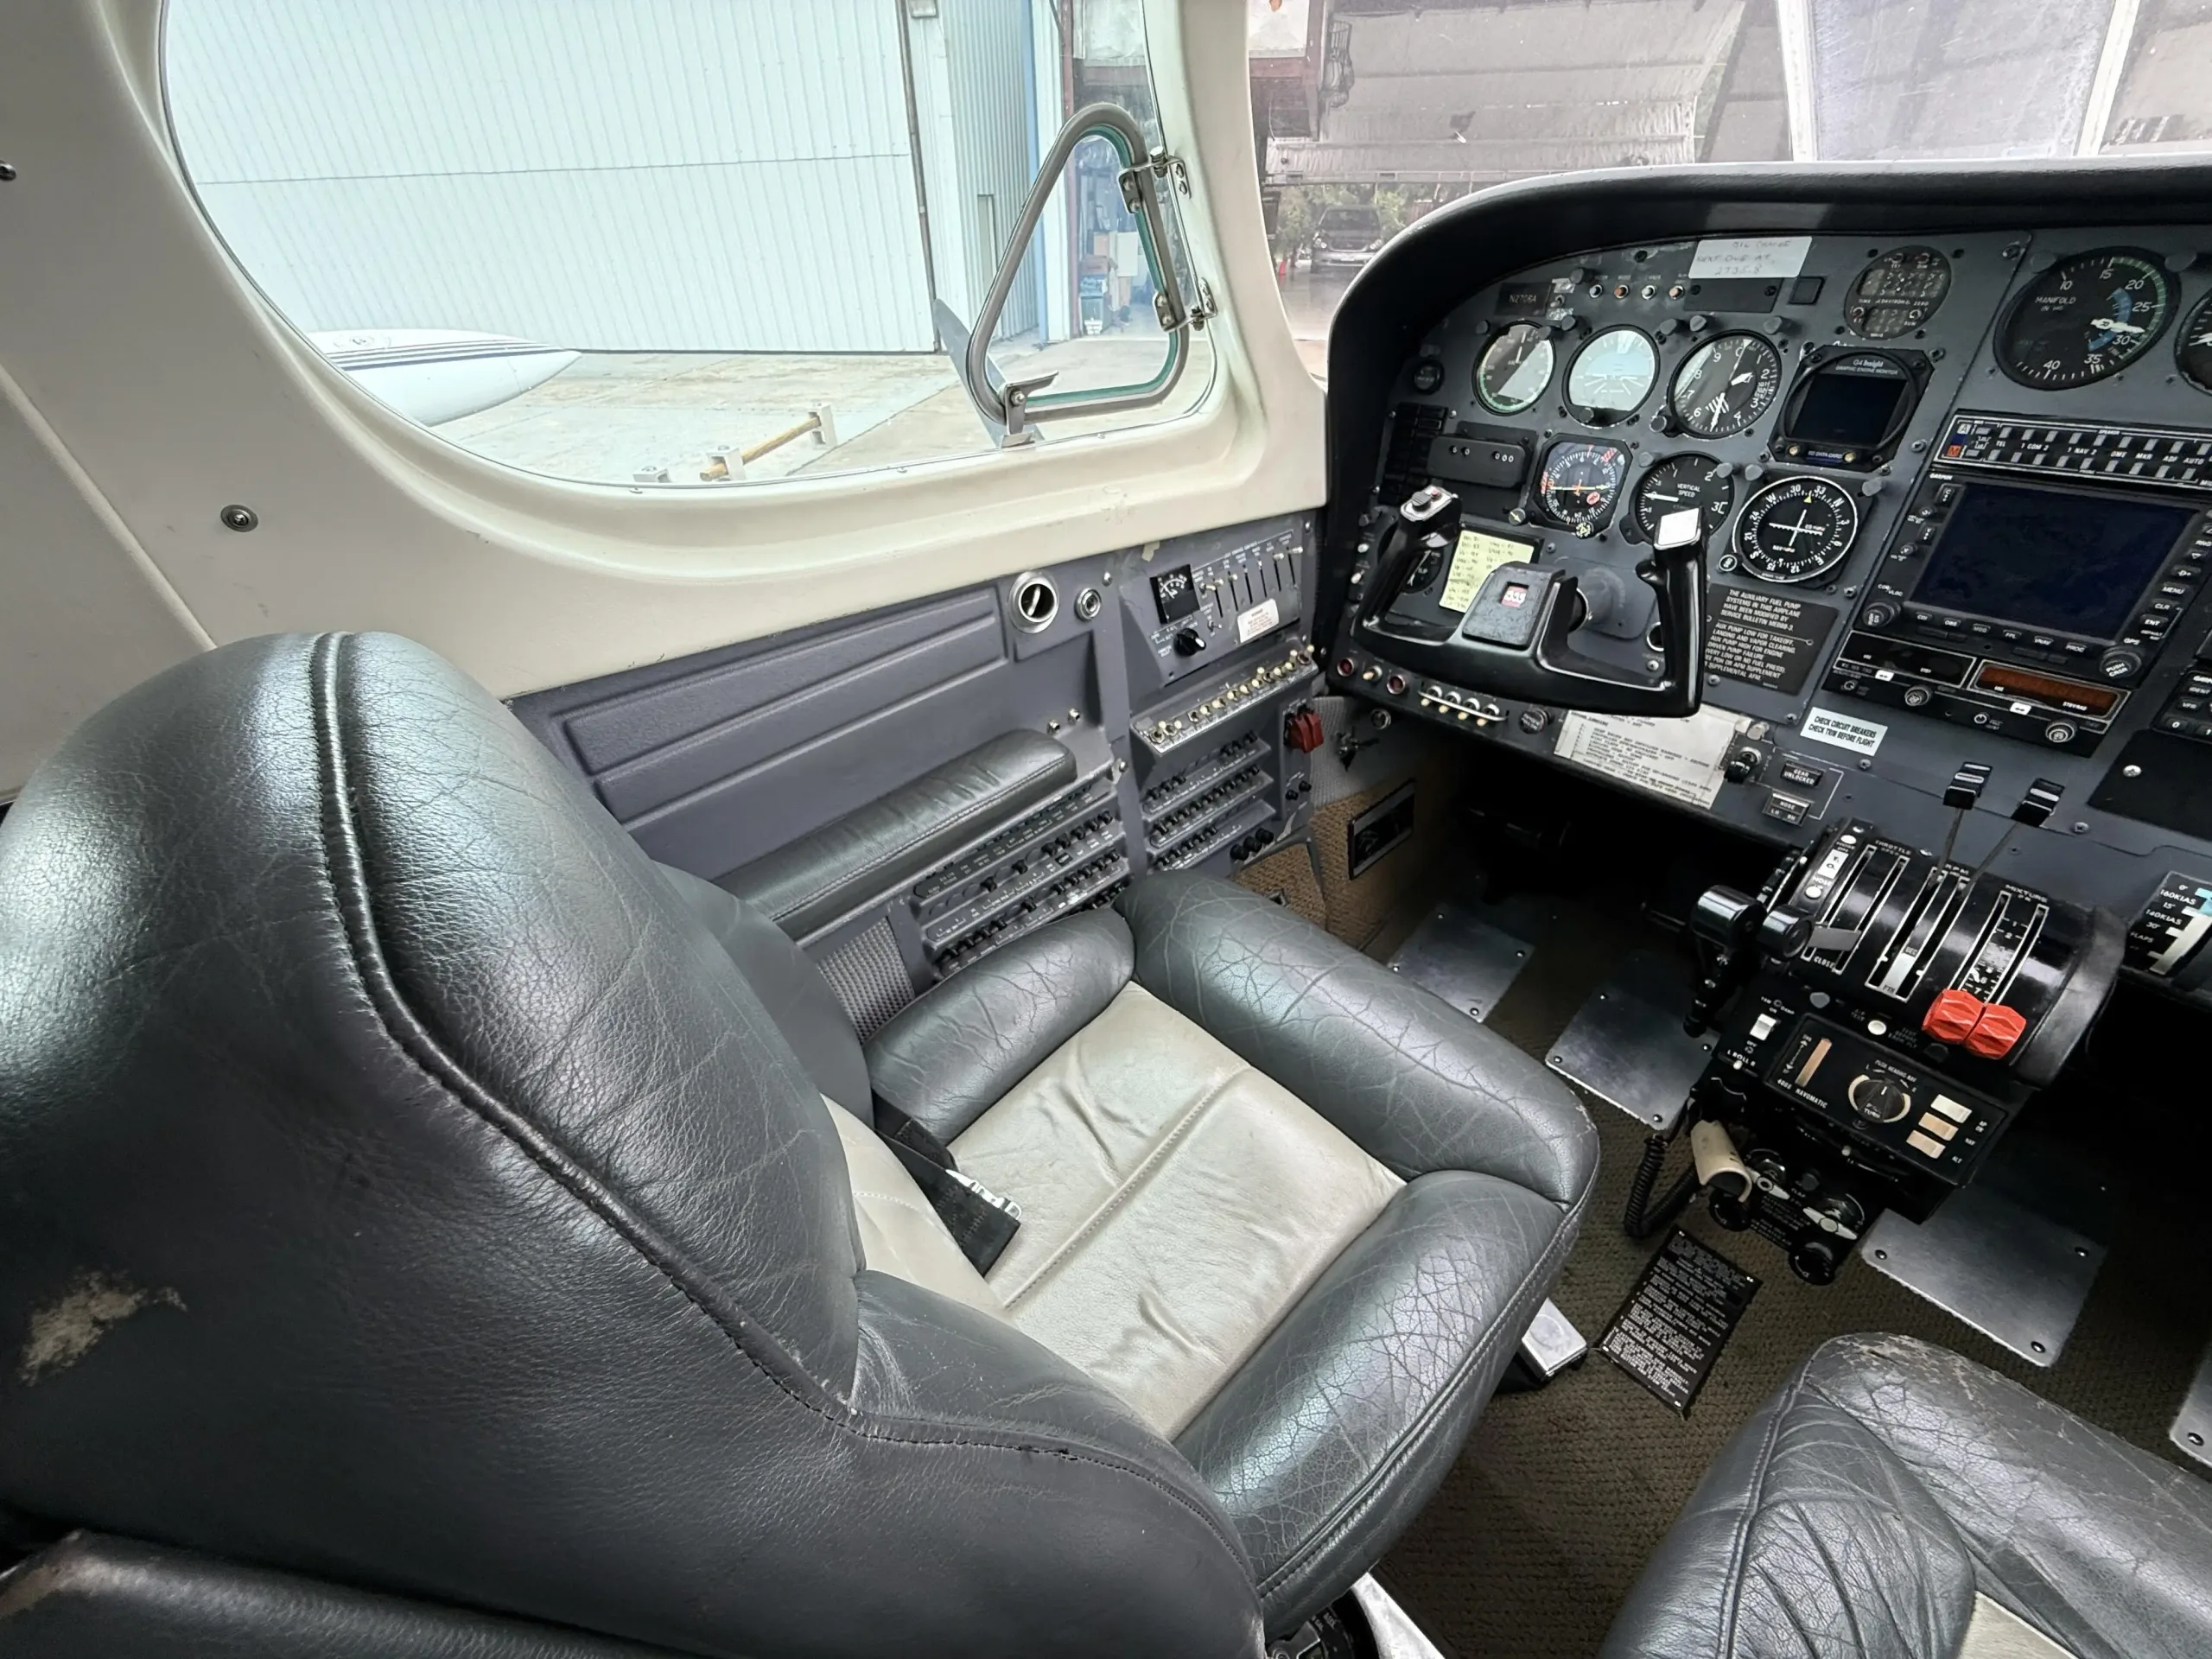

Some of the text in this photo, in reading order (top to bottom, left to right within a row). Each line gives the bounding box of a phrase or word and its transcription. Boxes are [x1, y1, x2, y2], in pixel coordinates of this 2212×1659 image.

[2100, 268, 2114, 279] 15
[2060, 281, 2073, 290] 10
[2125, 279, 2145, 290] 20
[2132, 302, 2152, 312] 25
[2112, 335, 2132, 345] 30
[1713, 353, 1722, 363] 9
[2084, 354, 2103, 364] 35
[2043, 359, 2061, 370] 40
[1694, 369, 1702, 379] 8
[1761, 368, 1770, 379] 2
[1687, 390, 1695, 399] 7
[1750, 397, 1758, 408] 3
[1694, 407, 1702, 417] 6
[1704, 471, 1713, 481] 2
[1677, 483, 1701, 493] VERTICAL
[1789, 484, 1802, 493] 30
[1814, 485, 1827, 495] 33
[1711, 501, 1718, 512] 3
[1833, 497, 1845, 507] N
[1749, 511, 1760, 520] 24
[1744, 531, 1753, 541] 21
[1790, 565, 1801, 574] 12
[2162, 586, 2185, 594] MENU
[1740, 591, 1769, 602] AUXILIARY
[1784, 601, 1802, 610] PUMP
[1726, 596, 1751, 607] SYSTEMS
[1773, 607, 1801, 618] AIRPLANE
[1720, 609, 1768, 625] SERVICE BULLETIN
[1754, 609, 1779, 620] MODIFIED
[1713, 629, 1767, 646] LANDING AND VAPOR
[1744, 628, 1756, 637] LOW
[1707, 642, 1726, 651] DRIVEN
[1743, 650, 1764, 660] FAILURE
[1764, 648, 1783, 658] ENGINE
[2065, 645, 2085, 653] PROC
[1752, 659, 1764, 668] FUEL
[2106, 663, 2126, 673] PUSH
[1708, 664, 1746, 677] SUPPLEMENTAL
[1733, 661, 1745, 670] AFM
[1746, 665, 1781, 678] SUPPLEMENT
[1814, 716, 1877, 738] CHECK CIRCUIT BREAKERS
[1808, 724, 1875, 747] CHECK TRIM BEFORE FLIGHT
[1794, 768, 1808, 777] GEAR
[1784, 772, 1814, 785] UNLOCKED
[1780, 801, 1796, 810] NOSE
[1836, 841, 1855, 849] NOSE
[1875, 840, 1911, 855] THROTTLE
[1945, 864, 1968, 874] RPM
[1813, 875, 1832, 887] NOSE
[2005, 884, 2048, 902] MIXTURE
[2160, 889, 2196, 905] 160KIAS
[2145, 909, 2182, 925] 140KIAS
[2130, 931, 2153, 943] FLAPS
[1732, 1052, 1750, 1064] ROLL
[1796, 1089, 1827, 1109] NAVOMATIC
[1865, 1109, 1880, 1118] TURN
